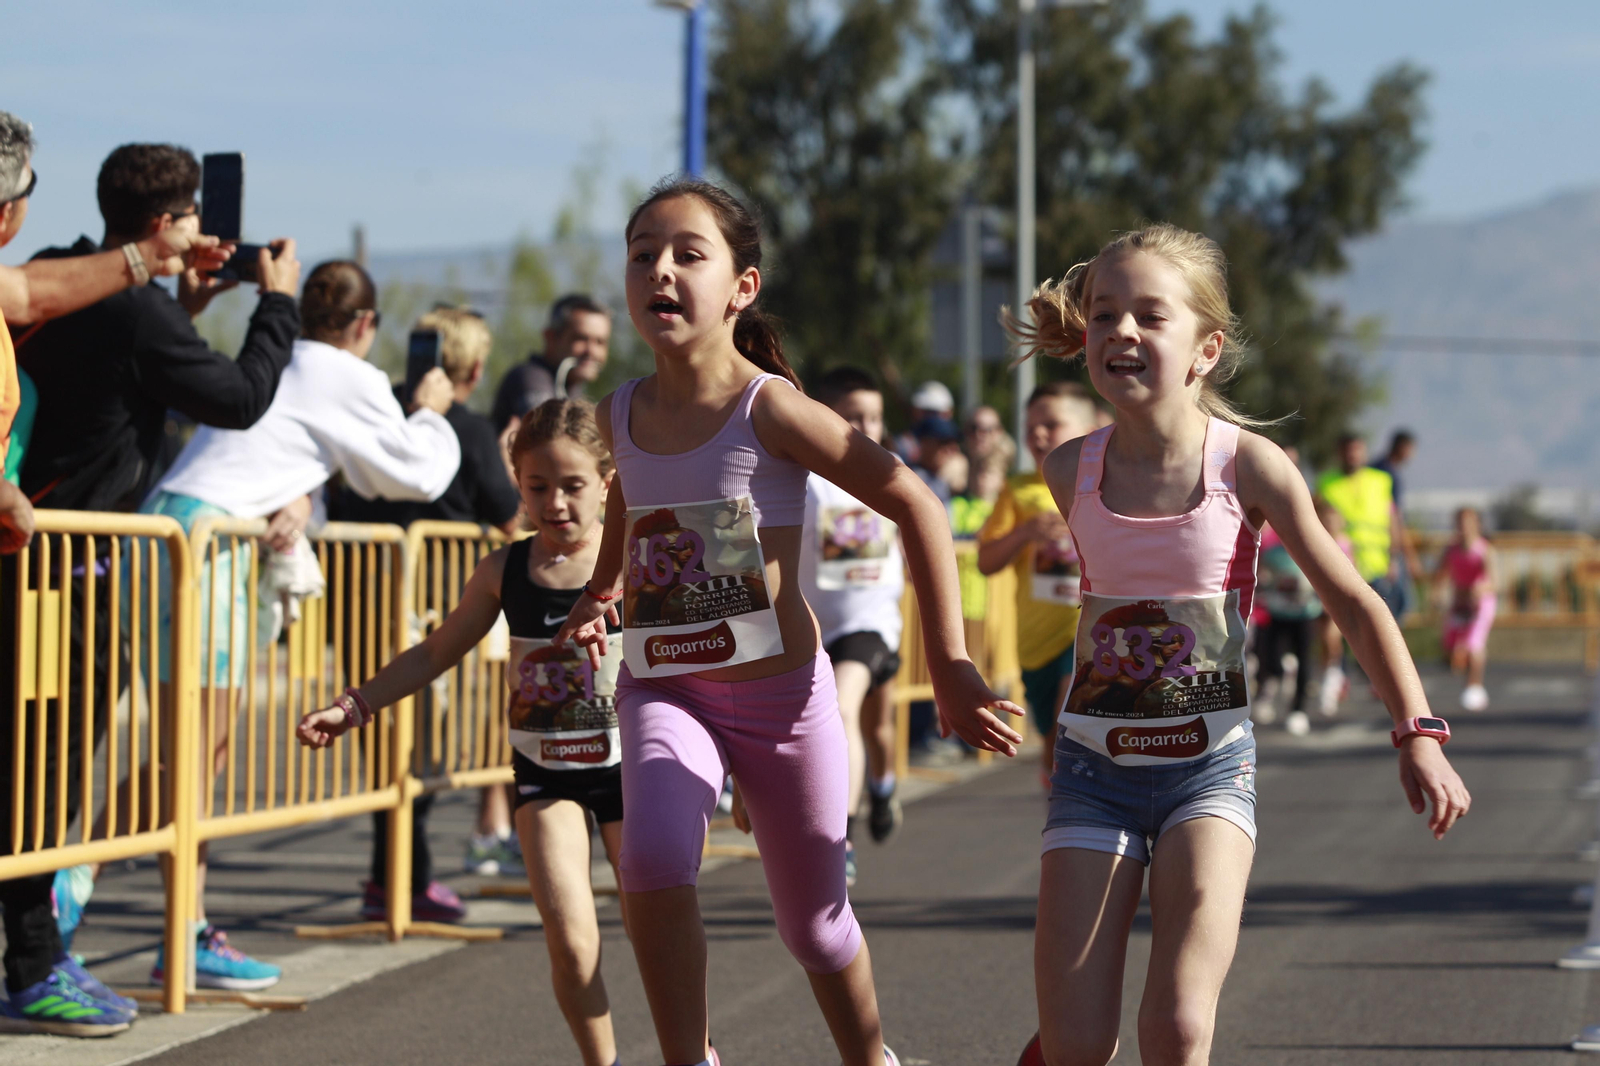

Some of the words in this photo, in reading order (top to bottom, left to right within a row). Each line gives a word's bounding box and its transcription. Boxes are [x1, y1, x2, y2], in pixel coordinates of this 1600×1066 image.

[628, 531, 711, 588] 862
[682, 575, 747, 595] XIII
[683, 587, 749, 602] CARRERA
[685, 593, 749, 609] POPULAR
[700, 599, 752, 614] ESPARTANOS
[1147, 602, 1165, 610] Carla
[686, 615, 706, 623] DEL
[708, 605, 752, 619] ALQUIÁN
[1090, 623, 1196, 681] 832
[519, 660, 595, 702] 831
[1163, 669, 1230, 690] XIII
[1163, 684, 1231, 697] CARRERA
[1164, 690, 1230, 704] POPULAR
[1178, 696, 1231, 708] ESPARTANOS
[1186, 702, 1230, 714] ALQUIÁN
